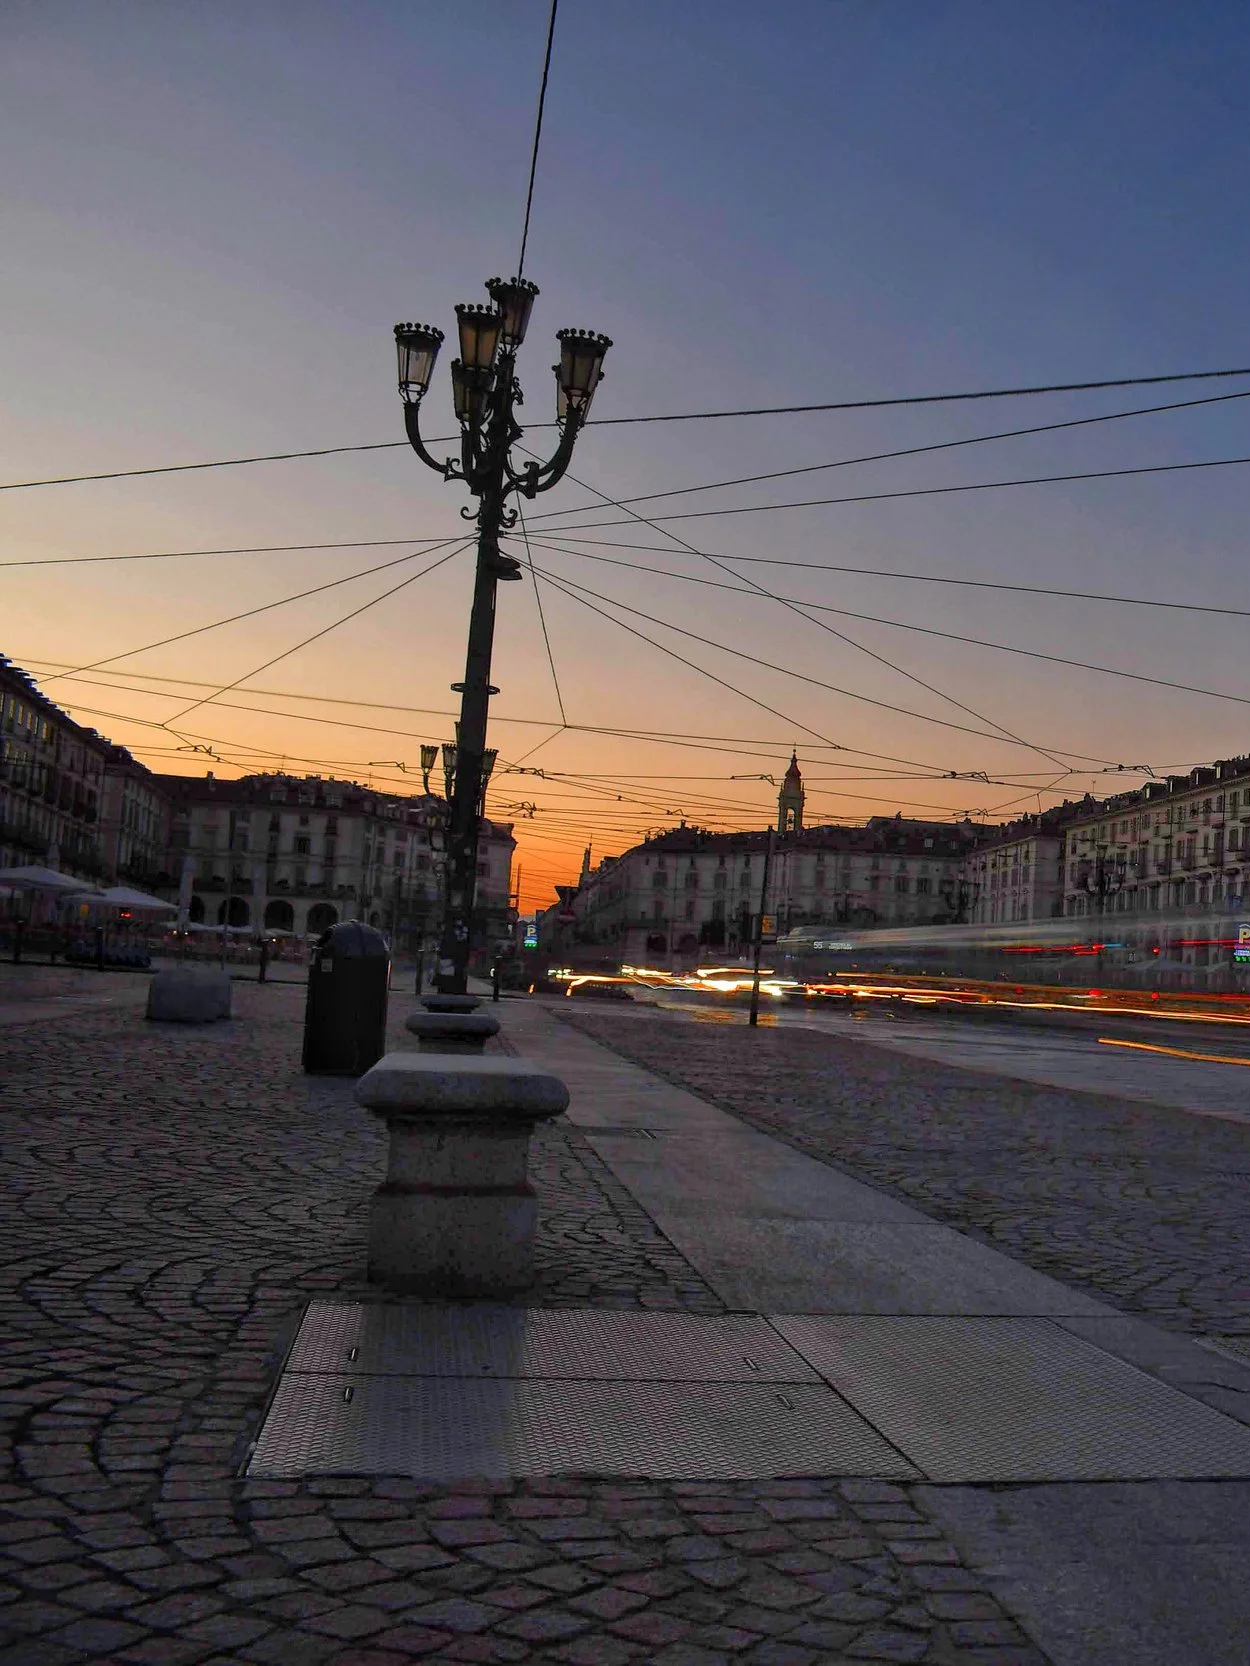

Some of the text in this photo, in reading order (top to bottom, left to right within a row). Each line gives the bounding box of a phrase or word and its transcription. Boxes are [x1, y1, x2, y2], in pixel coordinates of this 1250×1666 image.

[527, 927, 536, 936] P
[1239, 928, 1250, 944] P
[813, 941, 824, 949] 55
